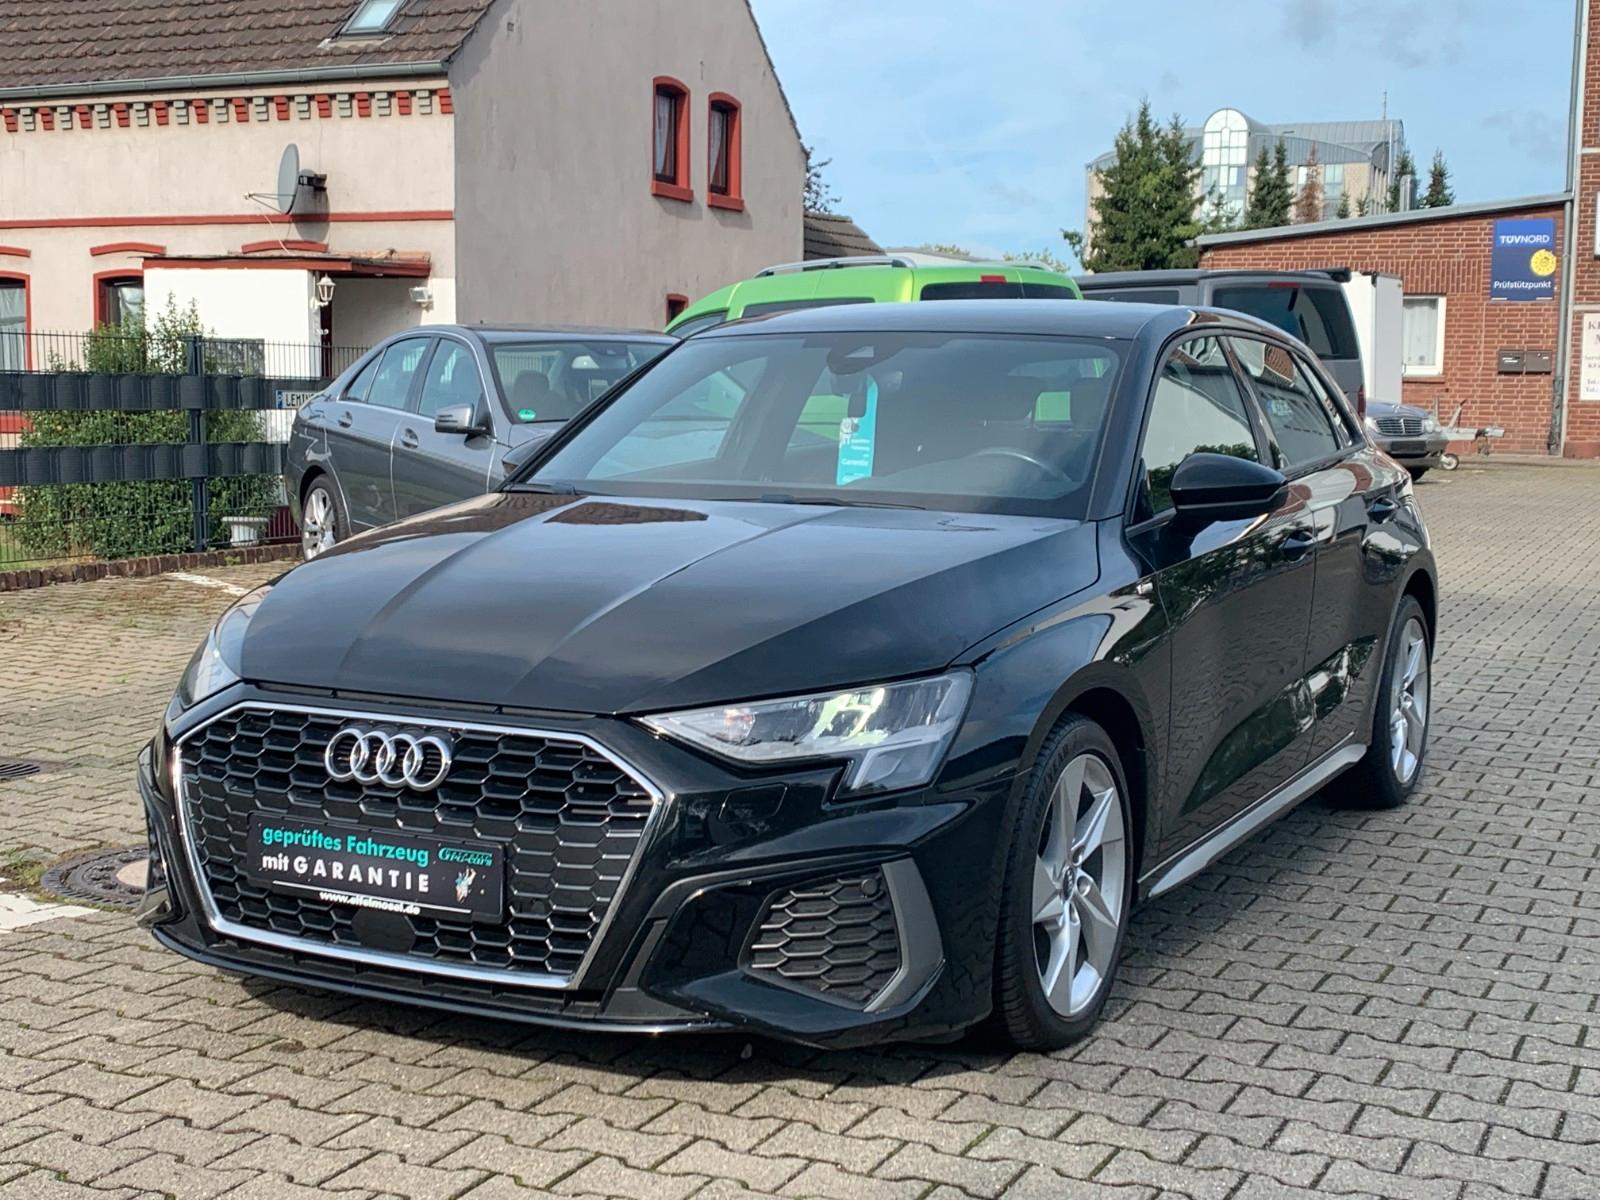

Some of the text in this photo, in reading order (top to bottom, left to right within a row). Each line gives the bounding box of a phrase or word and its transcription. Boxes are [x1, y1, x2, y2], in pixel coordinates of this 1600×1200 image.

[1494, 280, 1552, 290] Prüfstützpunkt
[262, 827, 430, 868] geprüftes Fahrzeug
[262, 852, 430, 893] mit GARANTIE
